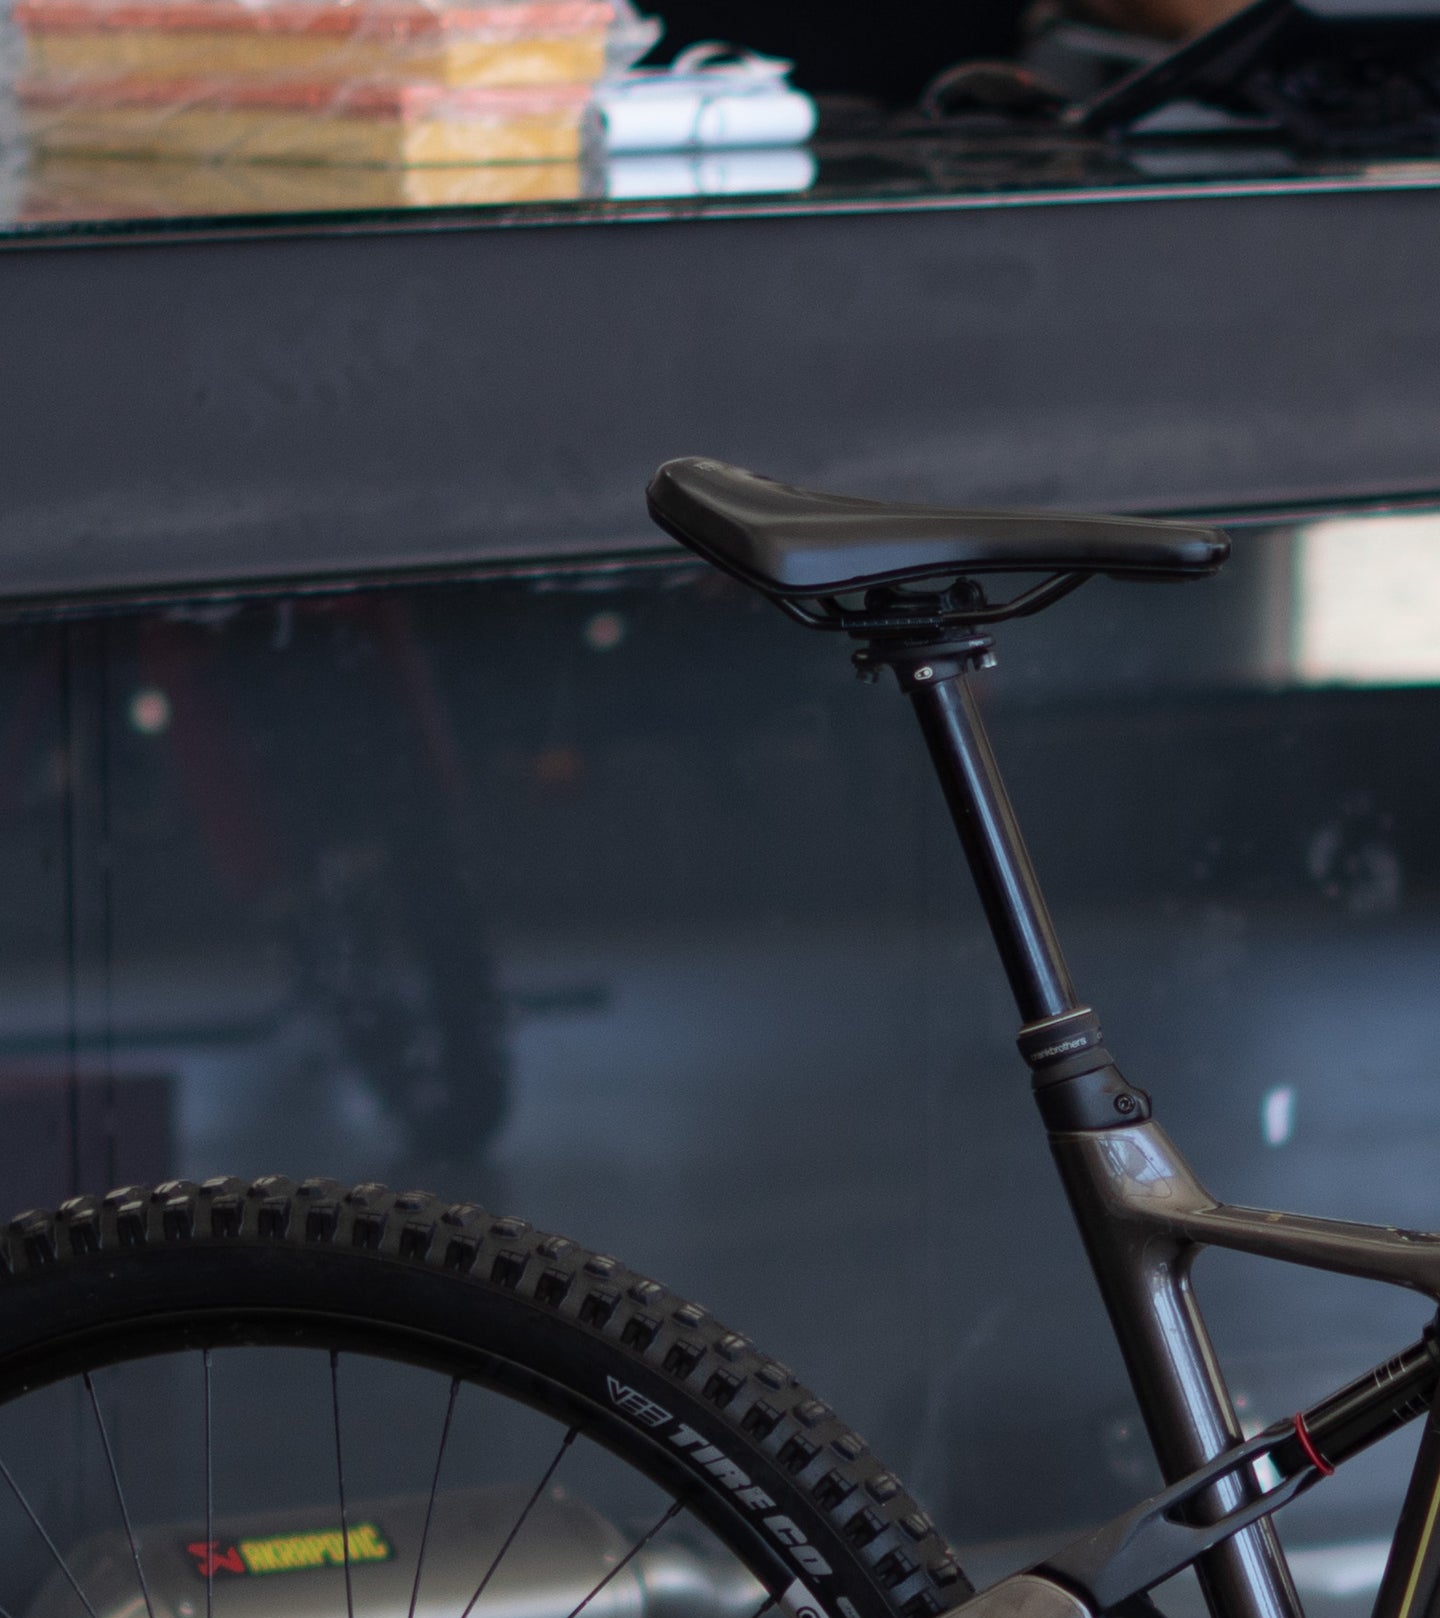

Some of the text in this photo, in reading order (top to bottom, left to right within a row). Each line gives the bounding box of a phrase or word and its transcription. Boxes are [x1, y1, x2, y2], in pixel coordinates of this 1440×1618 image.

[607, 1375, 833, 1583] VEE TIRE CO.
